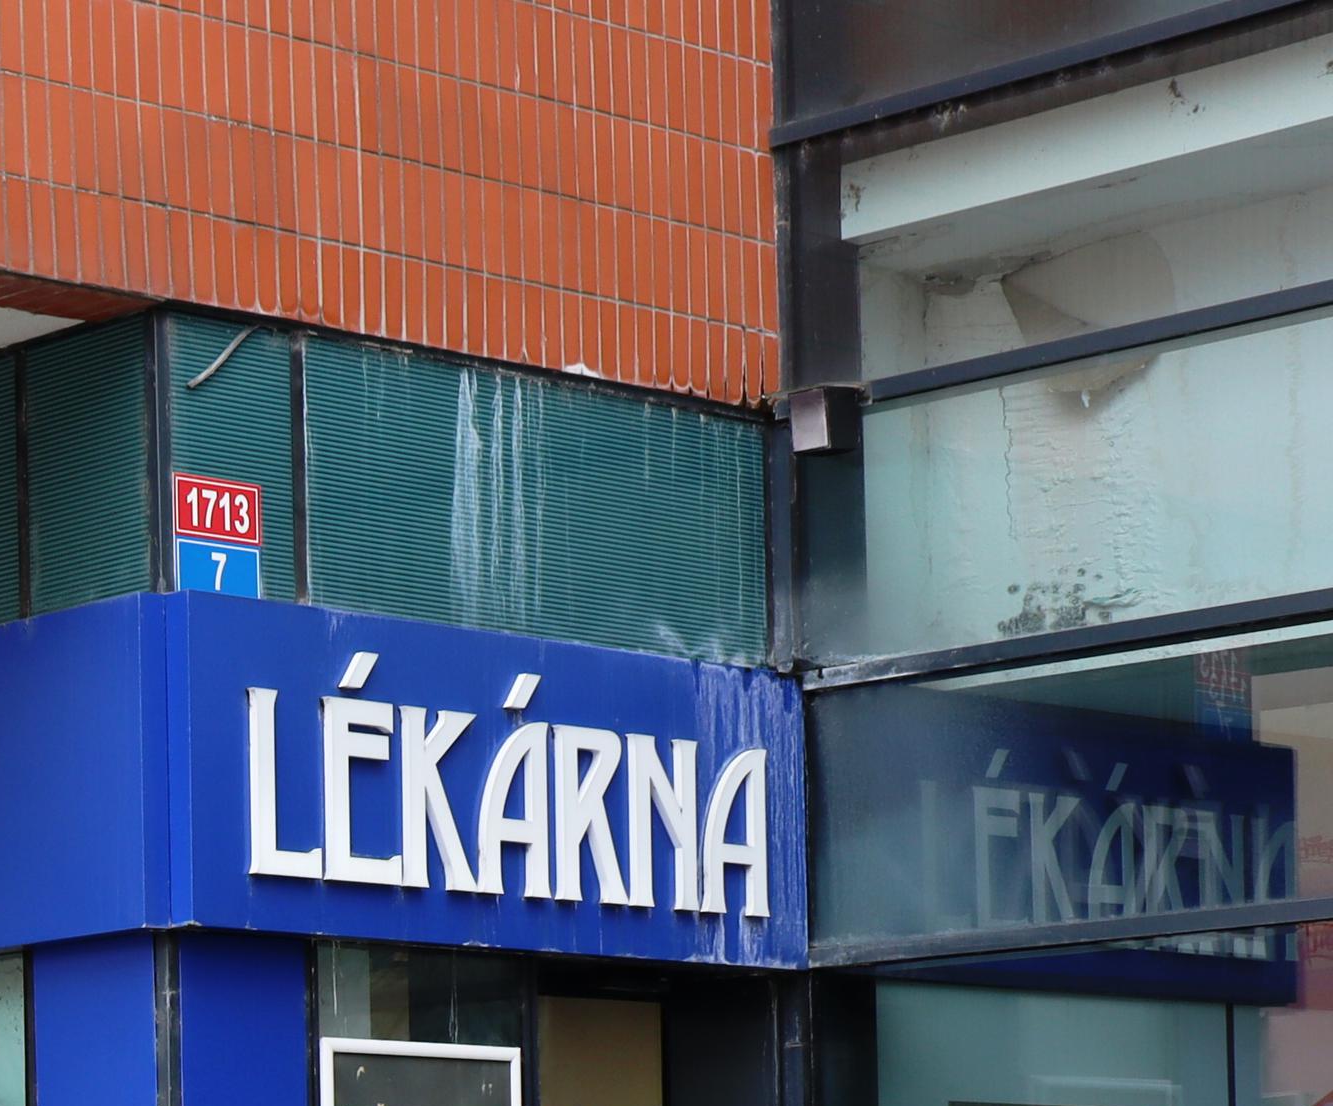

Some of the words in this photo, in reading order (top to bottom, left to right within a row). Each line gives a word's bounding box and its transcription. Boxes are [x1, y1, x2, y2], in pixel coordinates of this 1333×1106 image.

[186, 487, 250, 534] 1713
[211, 551, 227, 591] 7
[246, 651, 771, 918] LÉKÁRNA
